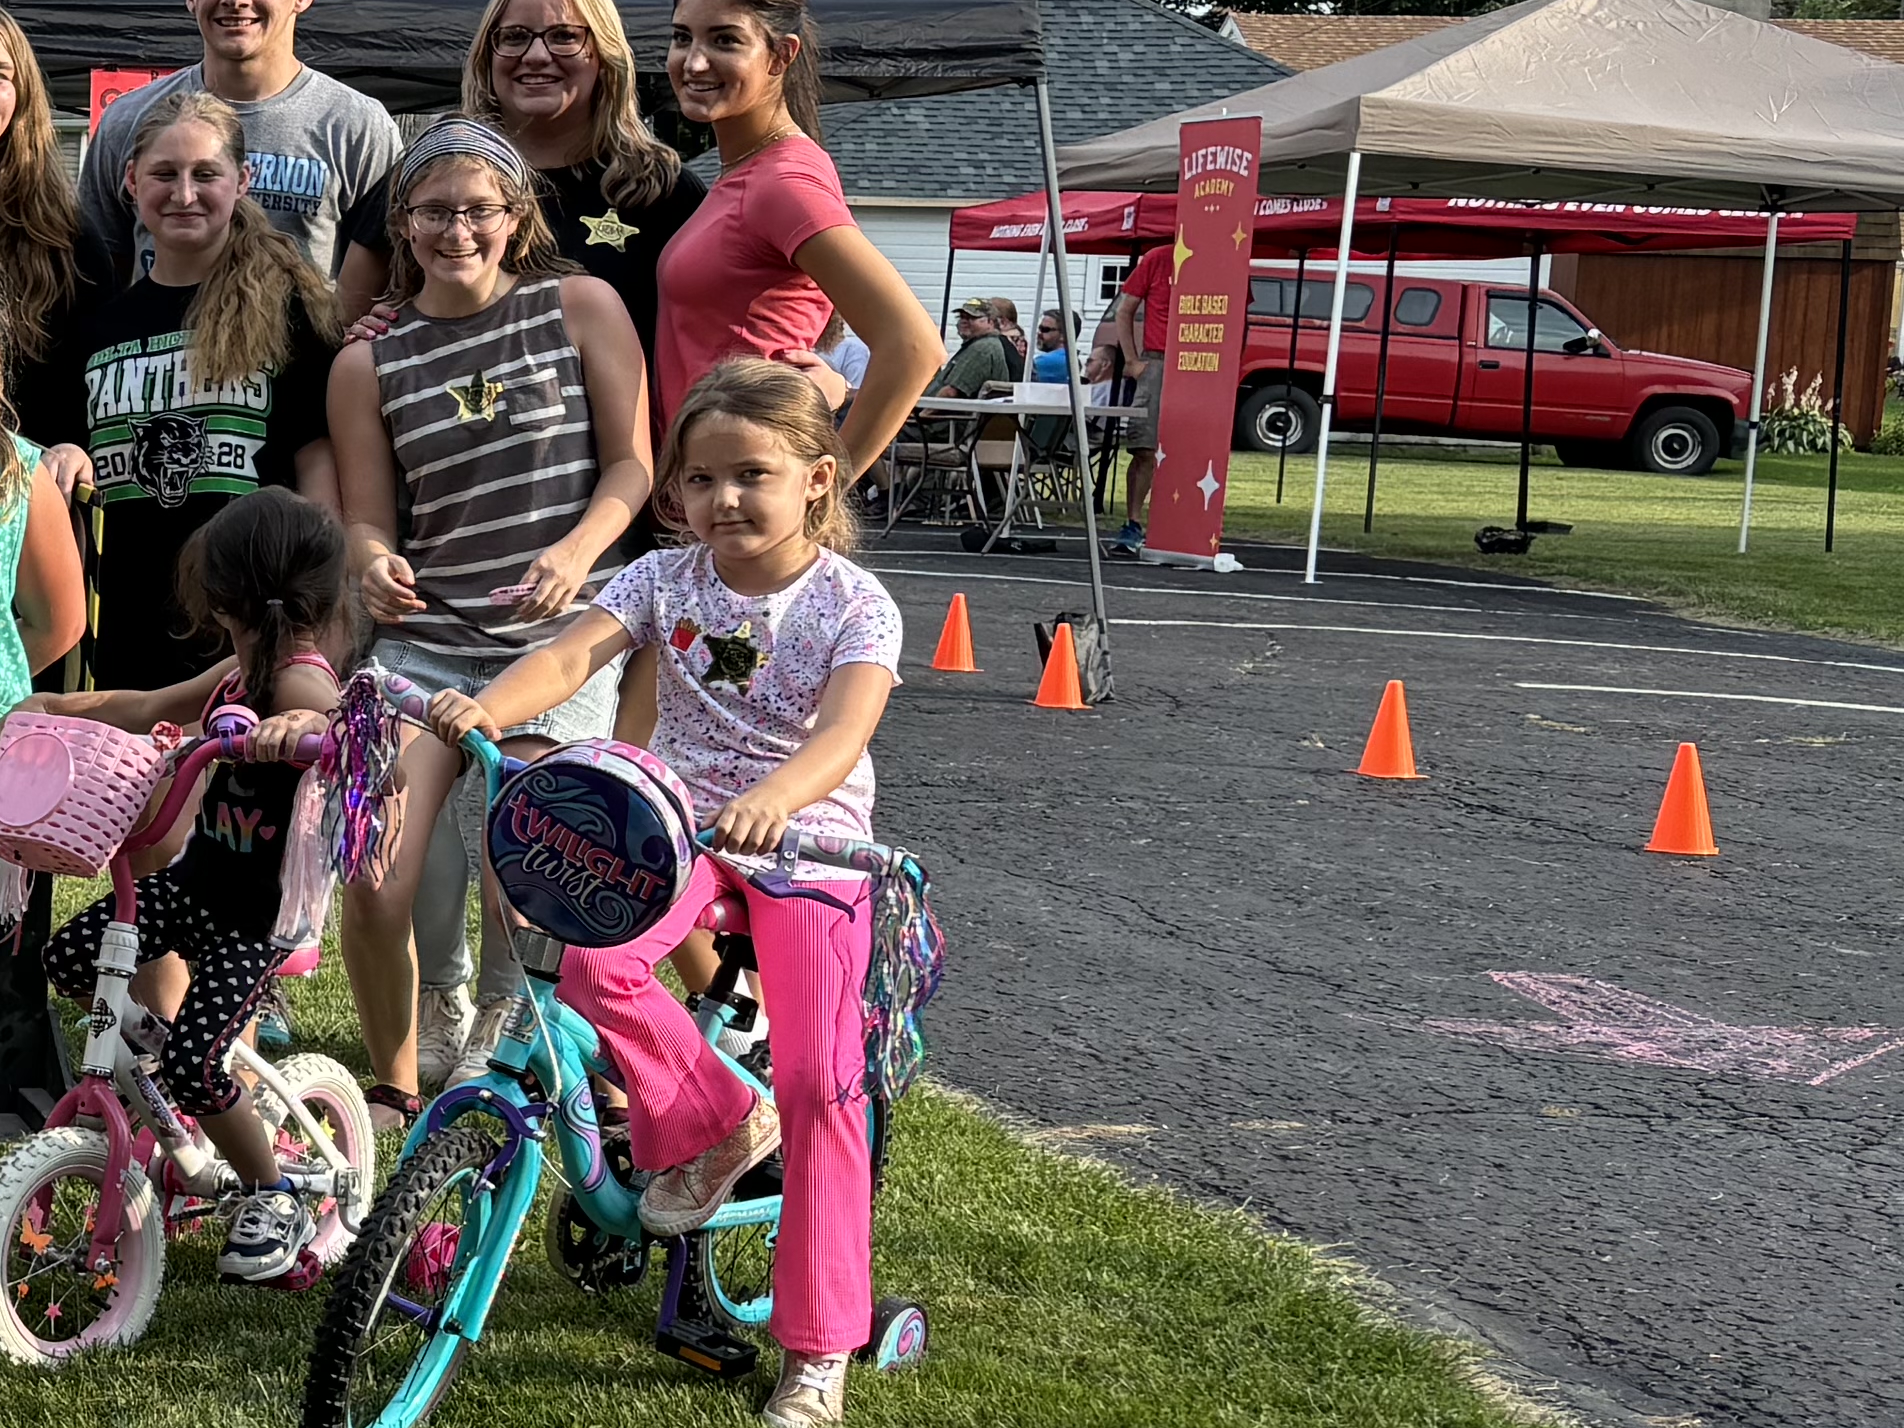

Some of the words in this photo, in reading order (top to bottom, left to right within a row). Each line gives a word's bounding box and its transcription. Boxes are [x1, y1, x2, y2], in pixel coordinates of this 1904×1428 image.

[245, 153, 326, 198] ERNON
[1183, 145, 1253, 180] LIFEWISE
[1194, 178, 1235, 200] ACADEMY
[1178, 323, 1224, 343] CHARACTER
[96, 452, 127, 481] 20
[217, 441, 247, 469] 28
[200, 801, 263, 852] LAY
